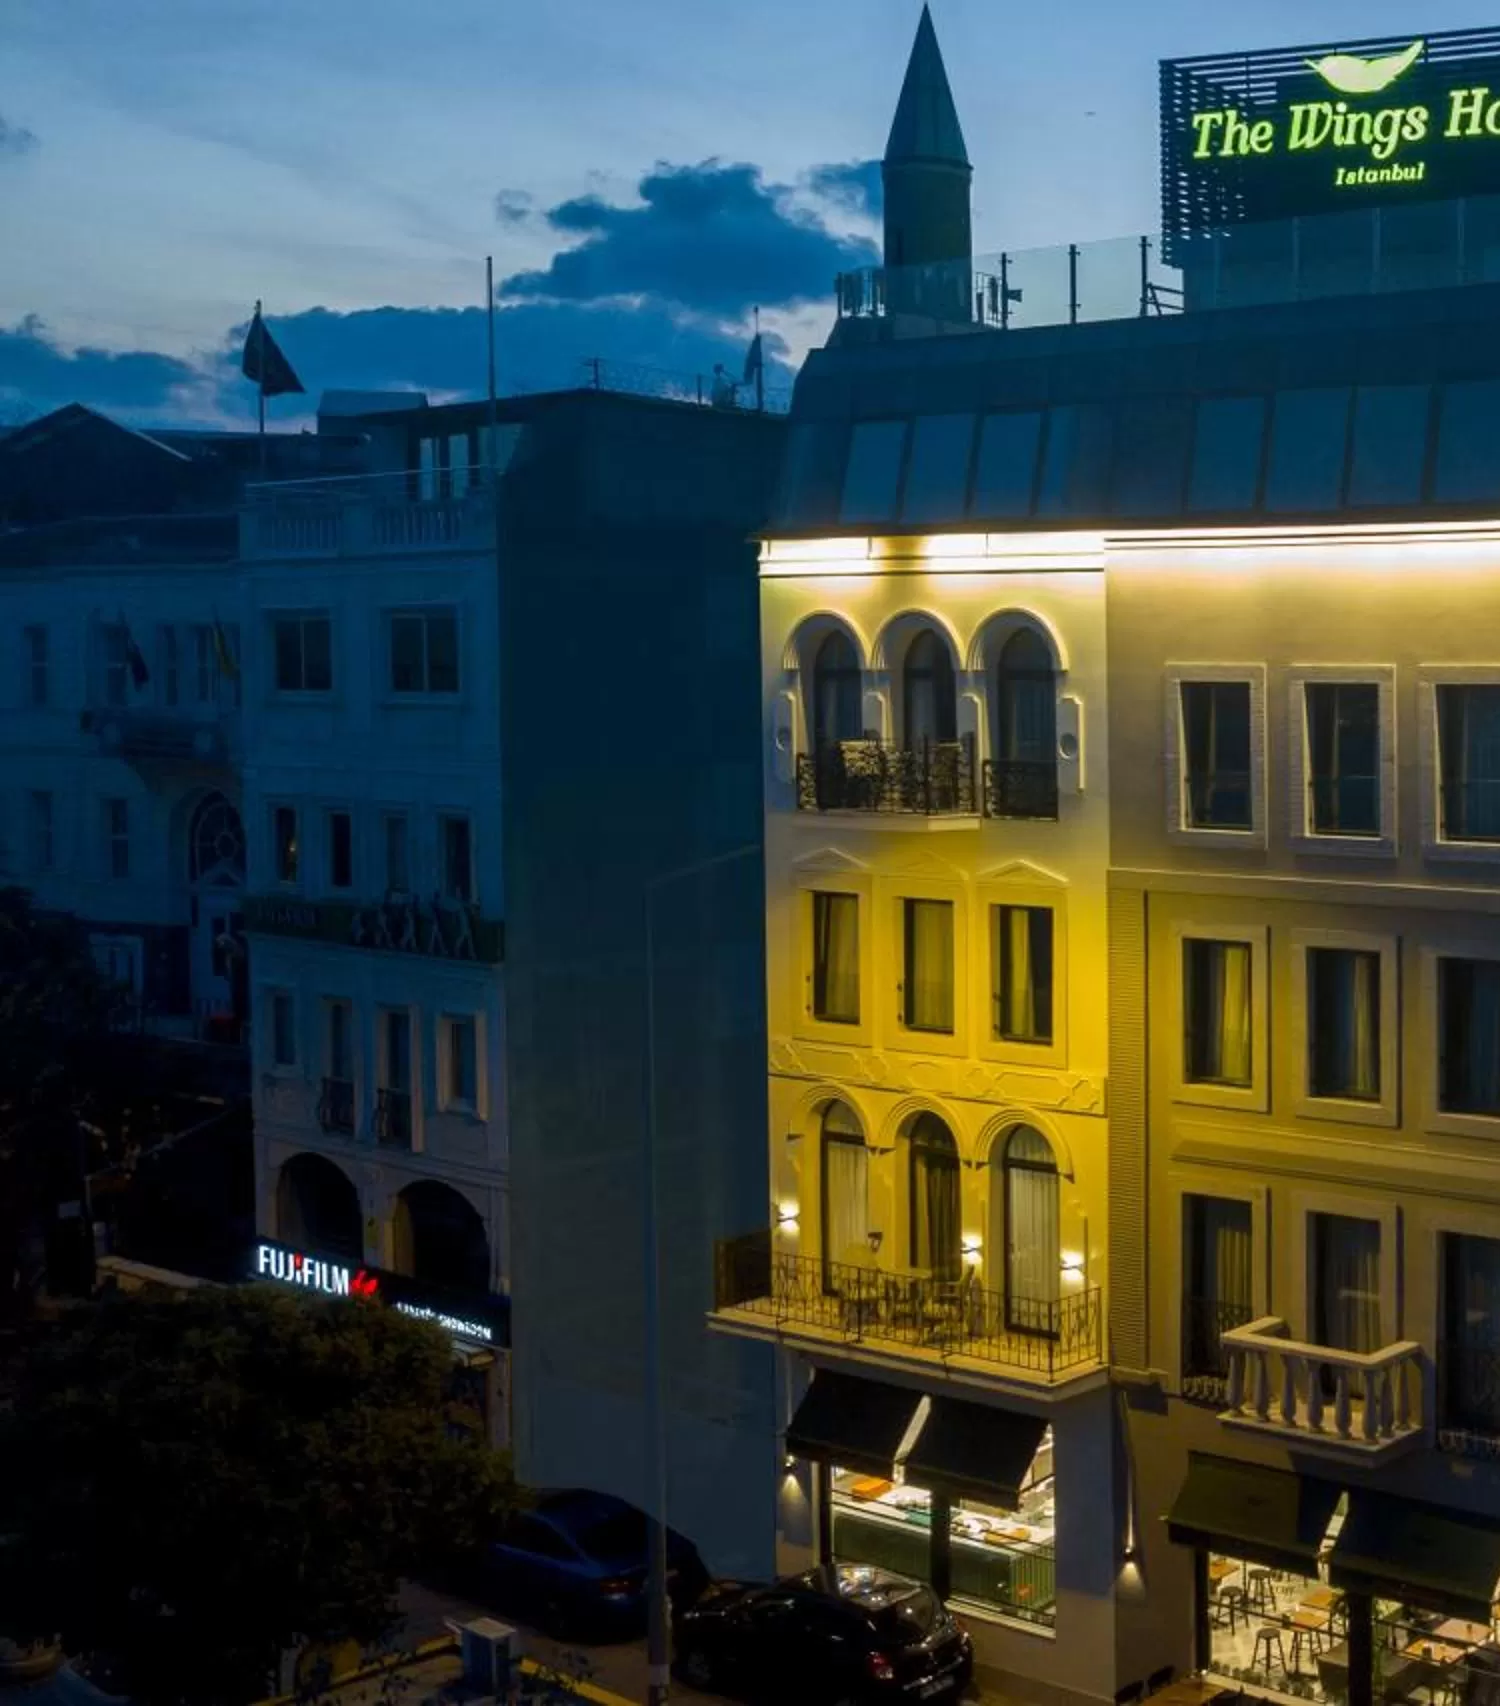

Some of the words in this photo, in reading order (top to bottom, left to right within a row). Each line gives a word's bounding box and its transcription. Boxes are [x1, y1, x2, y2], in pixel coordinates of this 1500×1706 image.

[1192, 109, 1274, 159] The
[1288, 101, 1429, 160] Wings
[1335, 161, 1425, 186] Istanbul
[258, 1244, 350, 1296] FUJIFILM
